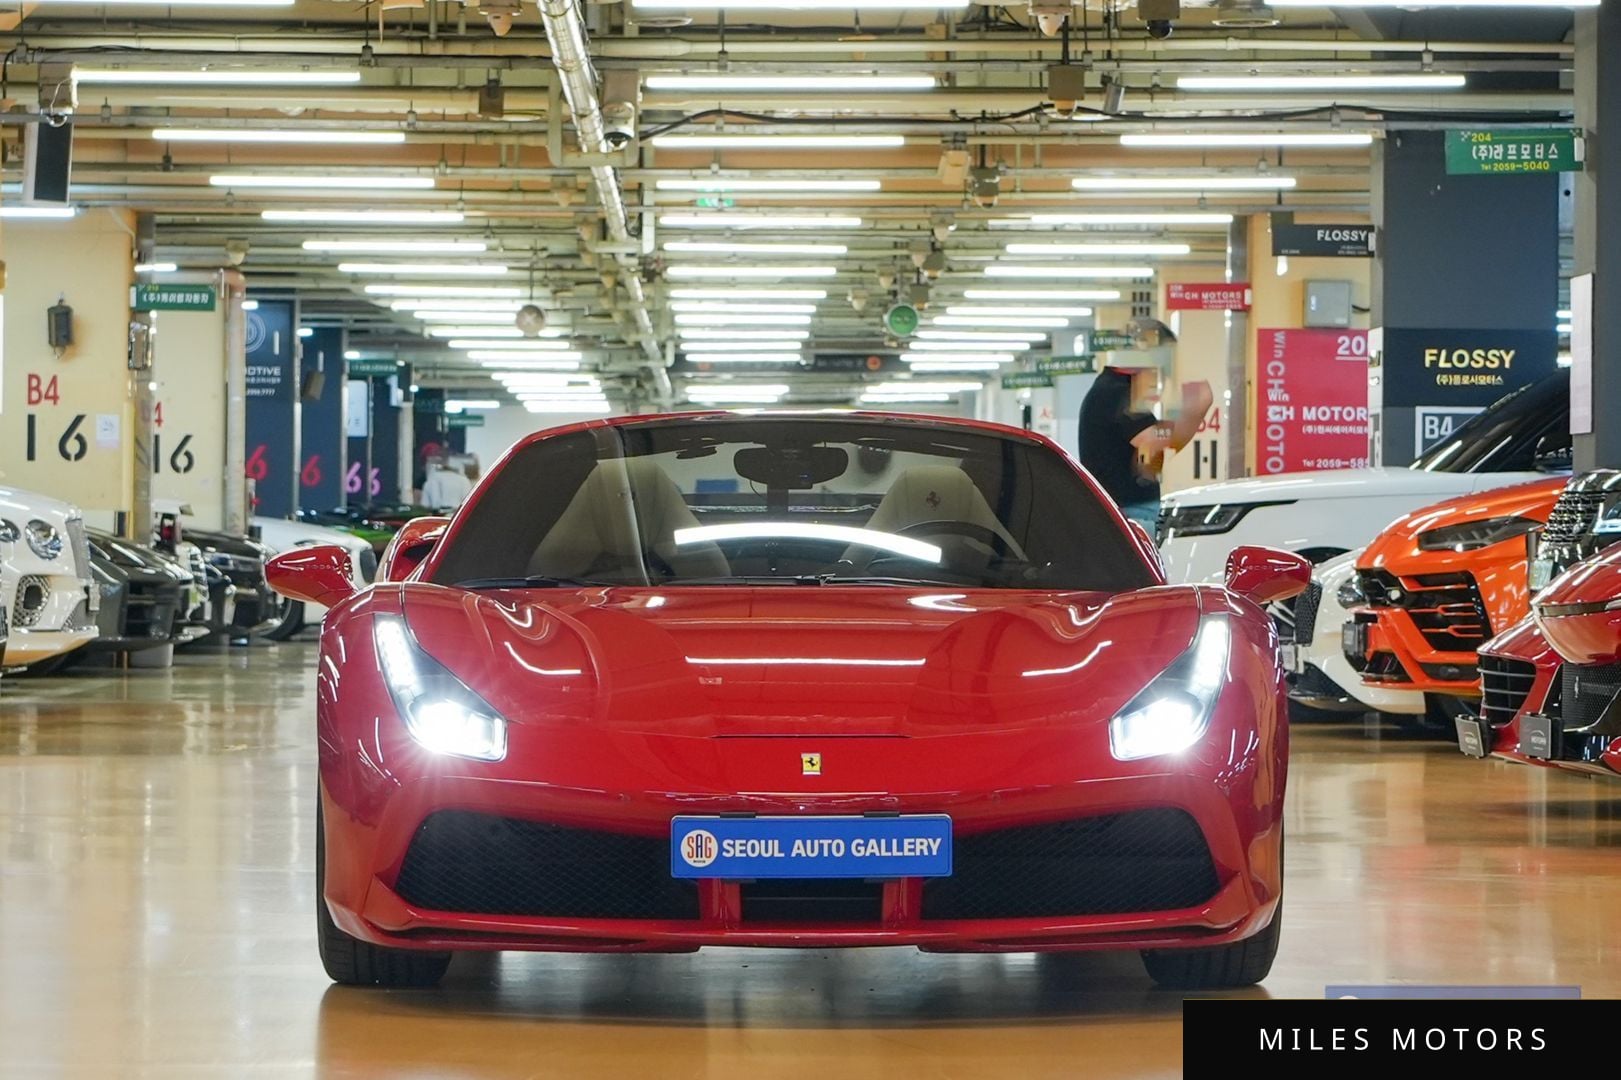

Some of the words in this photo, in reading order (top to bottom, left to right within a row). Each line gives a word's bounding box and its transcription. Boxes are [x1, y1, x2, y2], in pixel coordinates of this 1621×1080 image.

[1471, 133, 1492, 142] 204
[1493, 161, 1550, 171] 2059-5040
[1317, 229, 1368, 241] FLOSSY
[1201, 291, 1242, 300] MOTORS
[1424, 348, 1516, 369] FLOSSY
[27, 373, 60, 406] B4
[26, 413, 88, 462] 16
[1424, 415, 1453, 440] B4
[152, 434, 195, 474] 16
[687, 834, 712, 858] SAG
[722, 838, 785, 858] SEOUL
[791, 838, 845, 857] AUTO
[851, 837, 942, 857] GALLERY
